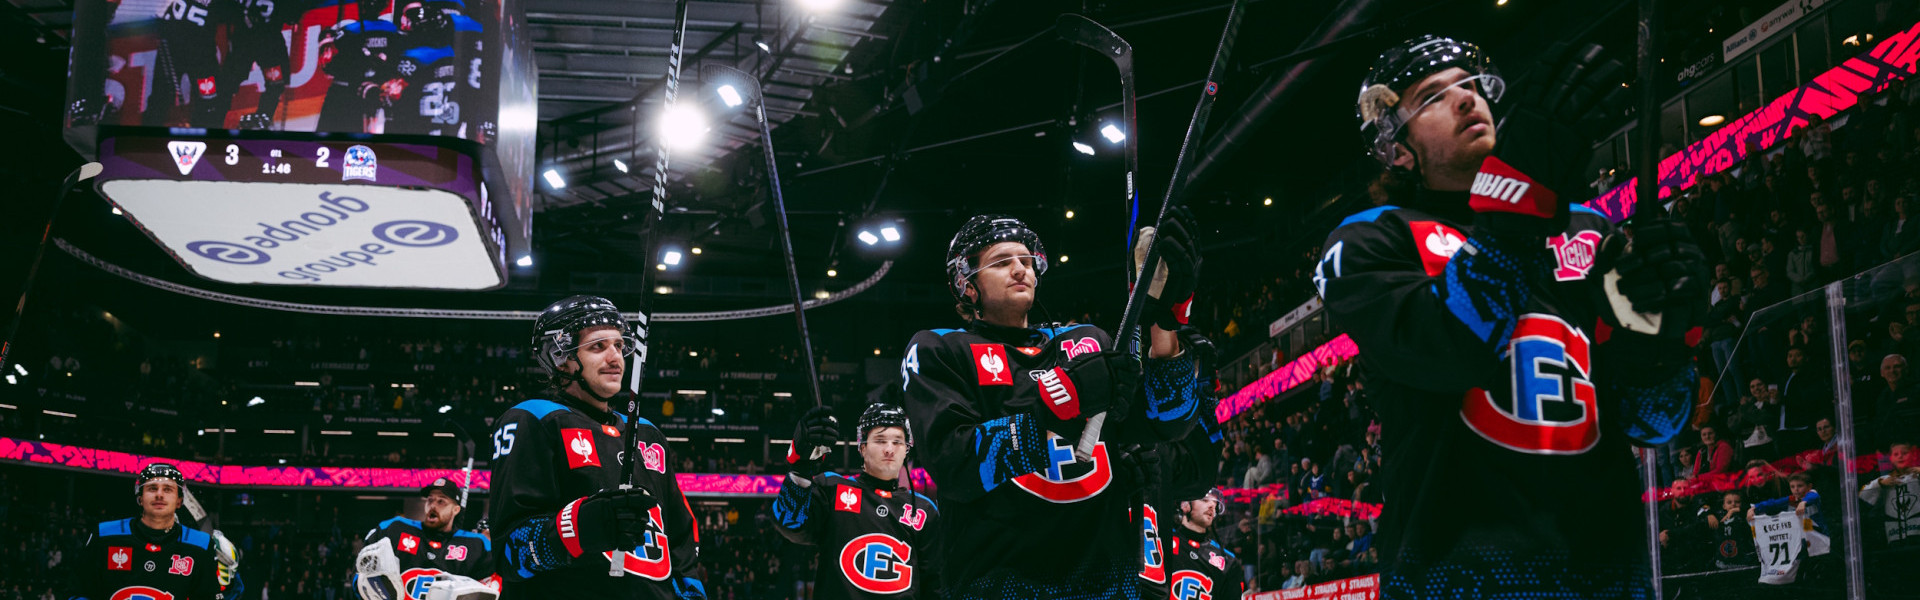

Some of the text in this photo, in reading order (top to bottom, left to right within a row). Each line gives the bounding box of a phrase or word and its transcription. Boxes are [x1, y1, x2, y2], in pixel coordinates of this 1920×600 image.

[1726, 37, 1748, 54] Allianz
[225, 144, 239, 165] 3
[316, 147, 330, 167] 2
[262, 163, 291, 174] 1:46
[345, 165, 375, 178] TIGERS
[244, 191, 370, 249] groupe
[278, 243, 395, 282] groupe
[731, 372, 763, 380] TERRASSE
[493, 423, 518, 460] 55
[1769, 542, 1791, 566] 71
[1282, 588, 1305, 599] STRAUSS
[1314, 582, 1338, 596] STRAUSS
[1349, 577, 1374, 590] STRAUSS
[1340, 591, 1366, 600] STRAUSS
